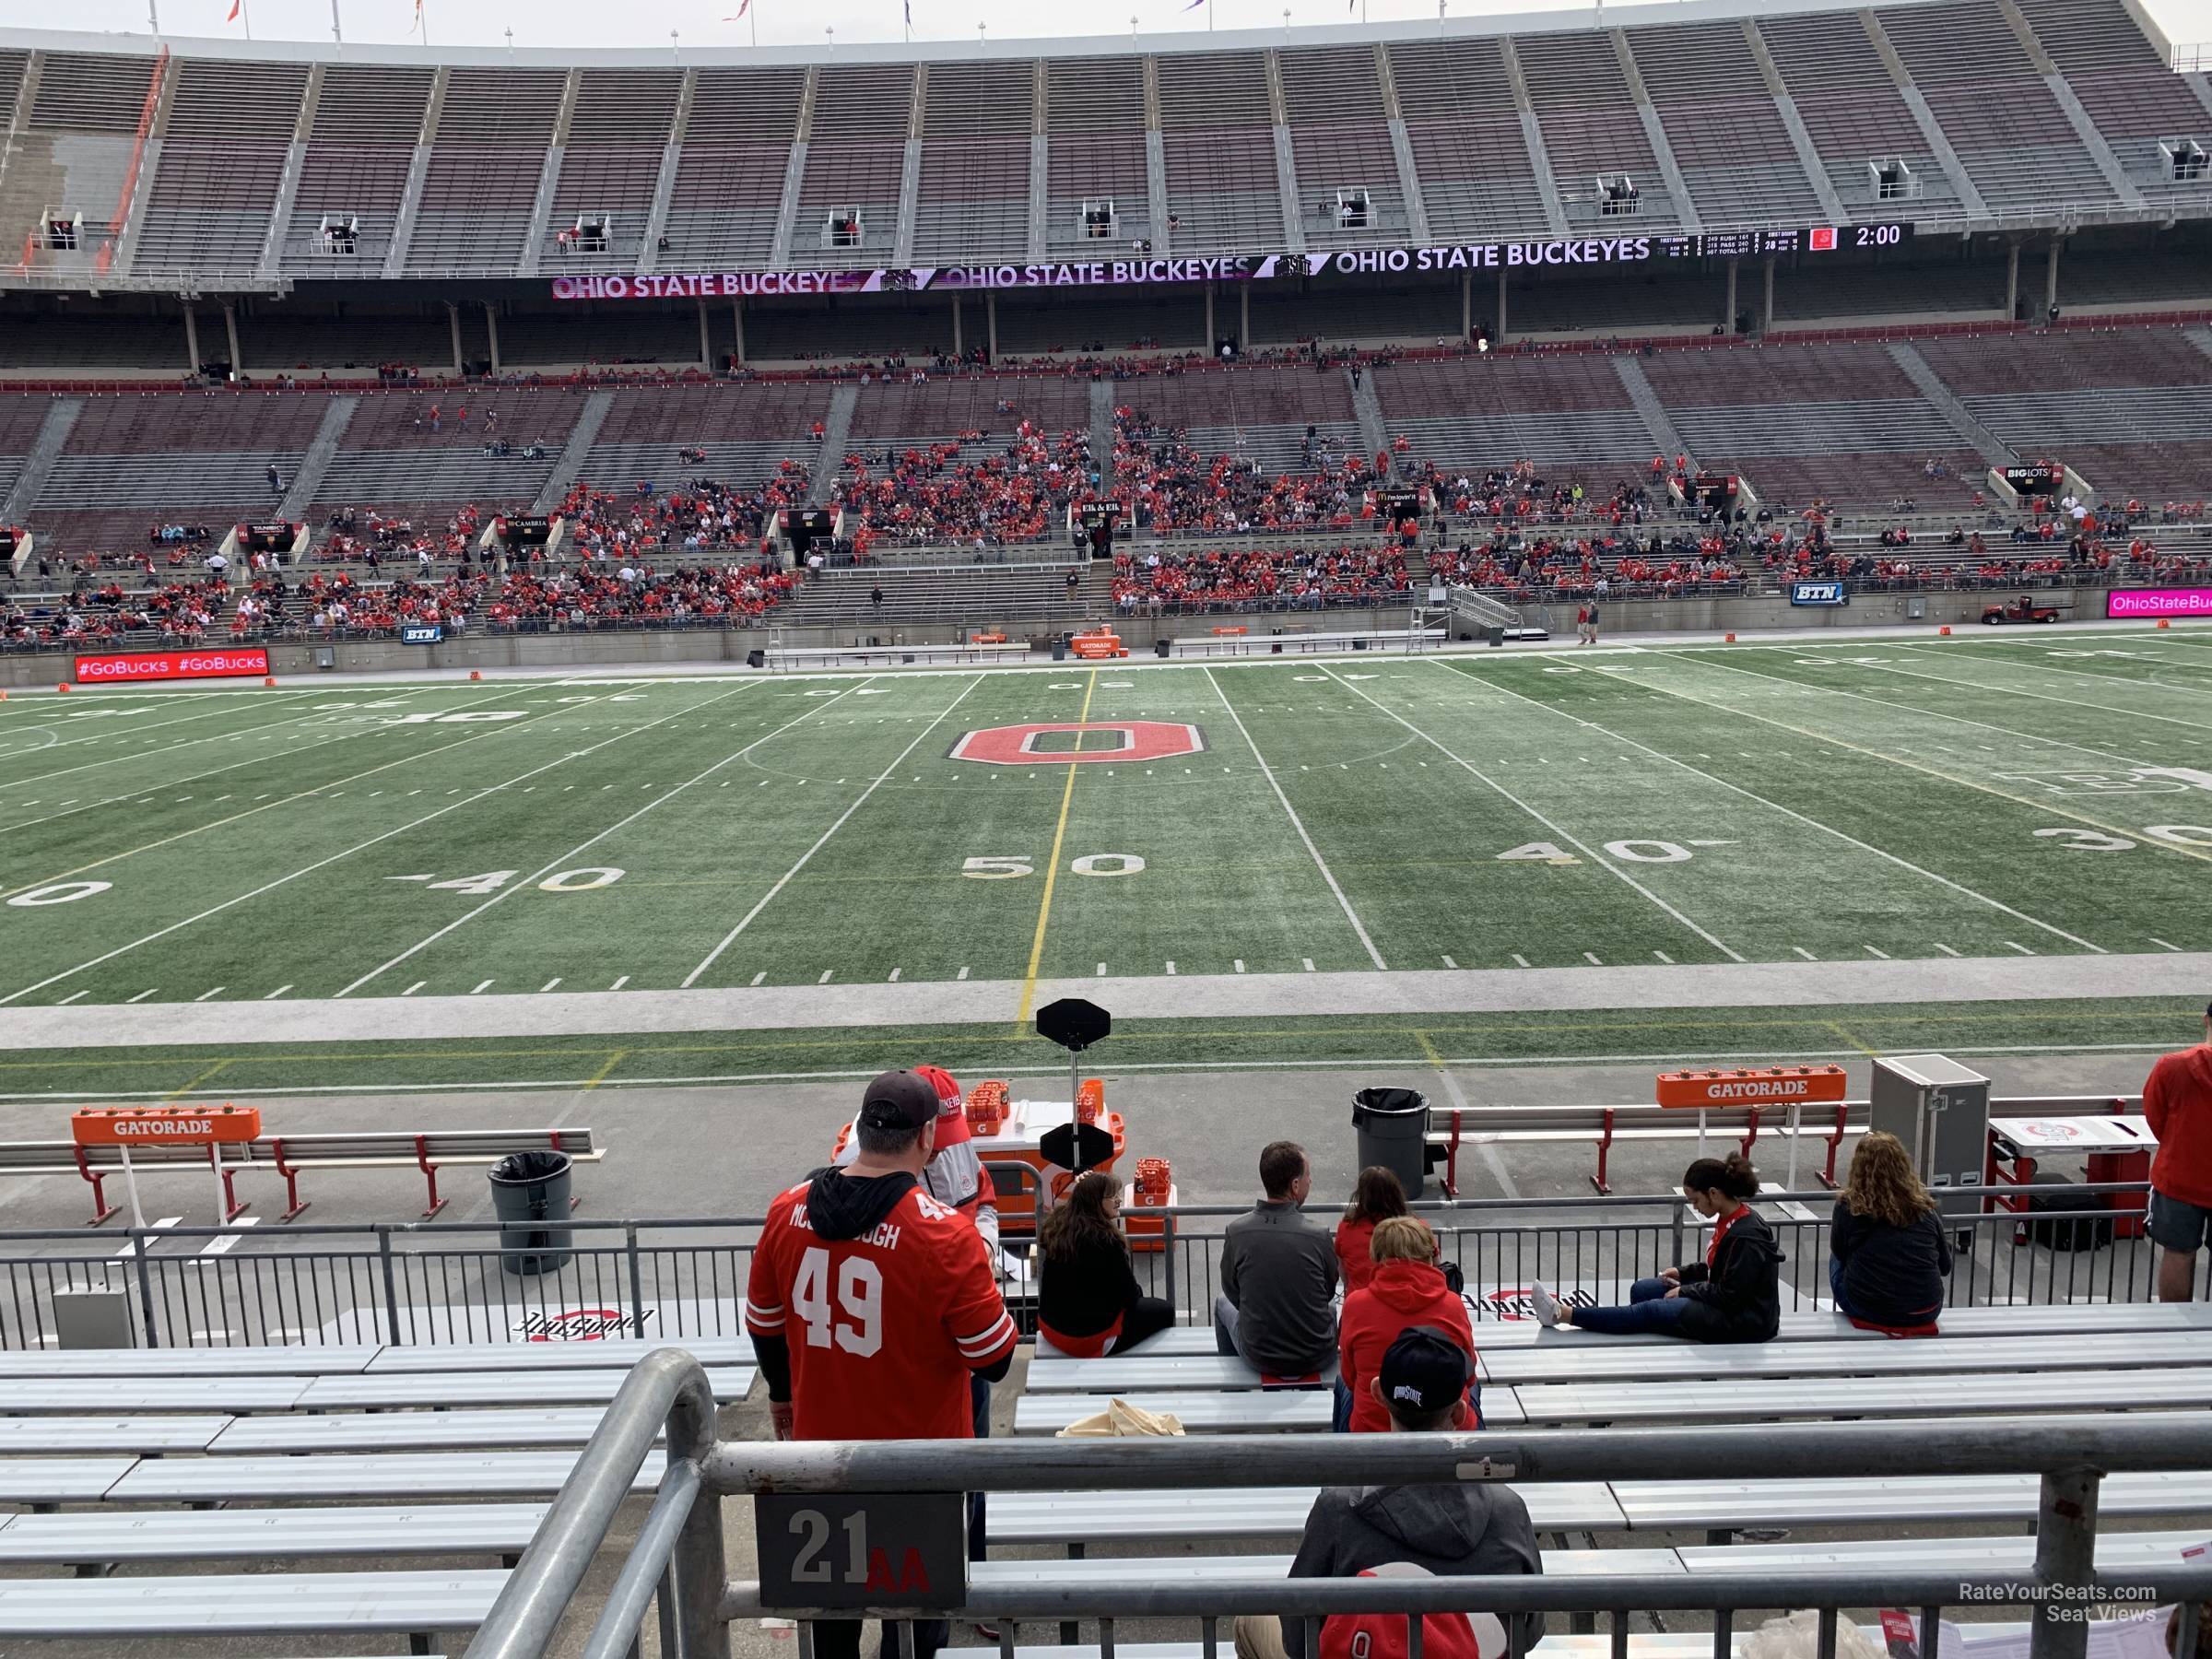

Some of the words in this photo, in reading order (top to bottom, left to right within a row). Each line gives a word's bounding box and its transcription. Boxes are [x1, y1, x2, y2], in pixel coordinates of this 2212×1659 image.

[1856, 225, 1900, 246] 2:00
[1764, 241, 1776, 250] 28
[1336, 251, 1409, 274] OHIO
[1417, 245, 1499, 270] STATE
[1507, 237, 1652, 266] BUCKEYES
[946, 265, 1017, 288] OHIO
[1024, 263, 1104, 286] STATE
[1112, 255, 1251, 283] BUCKEYES
[552, 276, 627, 299] OHIO
[633, 274, 715, 297] STATE
[1082, 504, 1096, 512] Elk
[1097, 503, 1105, 512] &
[1106, 503, 1121, 512] Elk
[1796, 586, 1837, 599] BTN
[406, 629, 436, 640] BTN
[1707, 1080, 1807, 1099] GATORADE
[113, 1120, 213, 1135] GATORADE
[977, 1123, 987, 1134] G
[1145, 1195, 1154, 1206] G
[792, 1246, 883, 1359] 49
[1405, 1385, 1422, 1406] STATE
